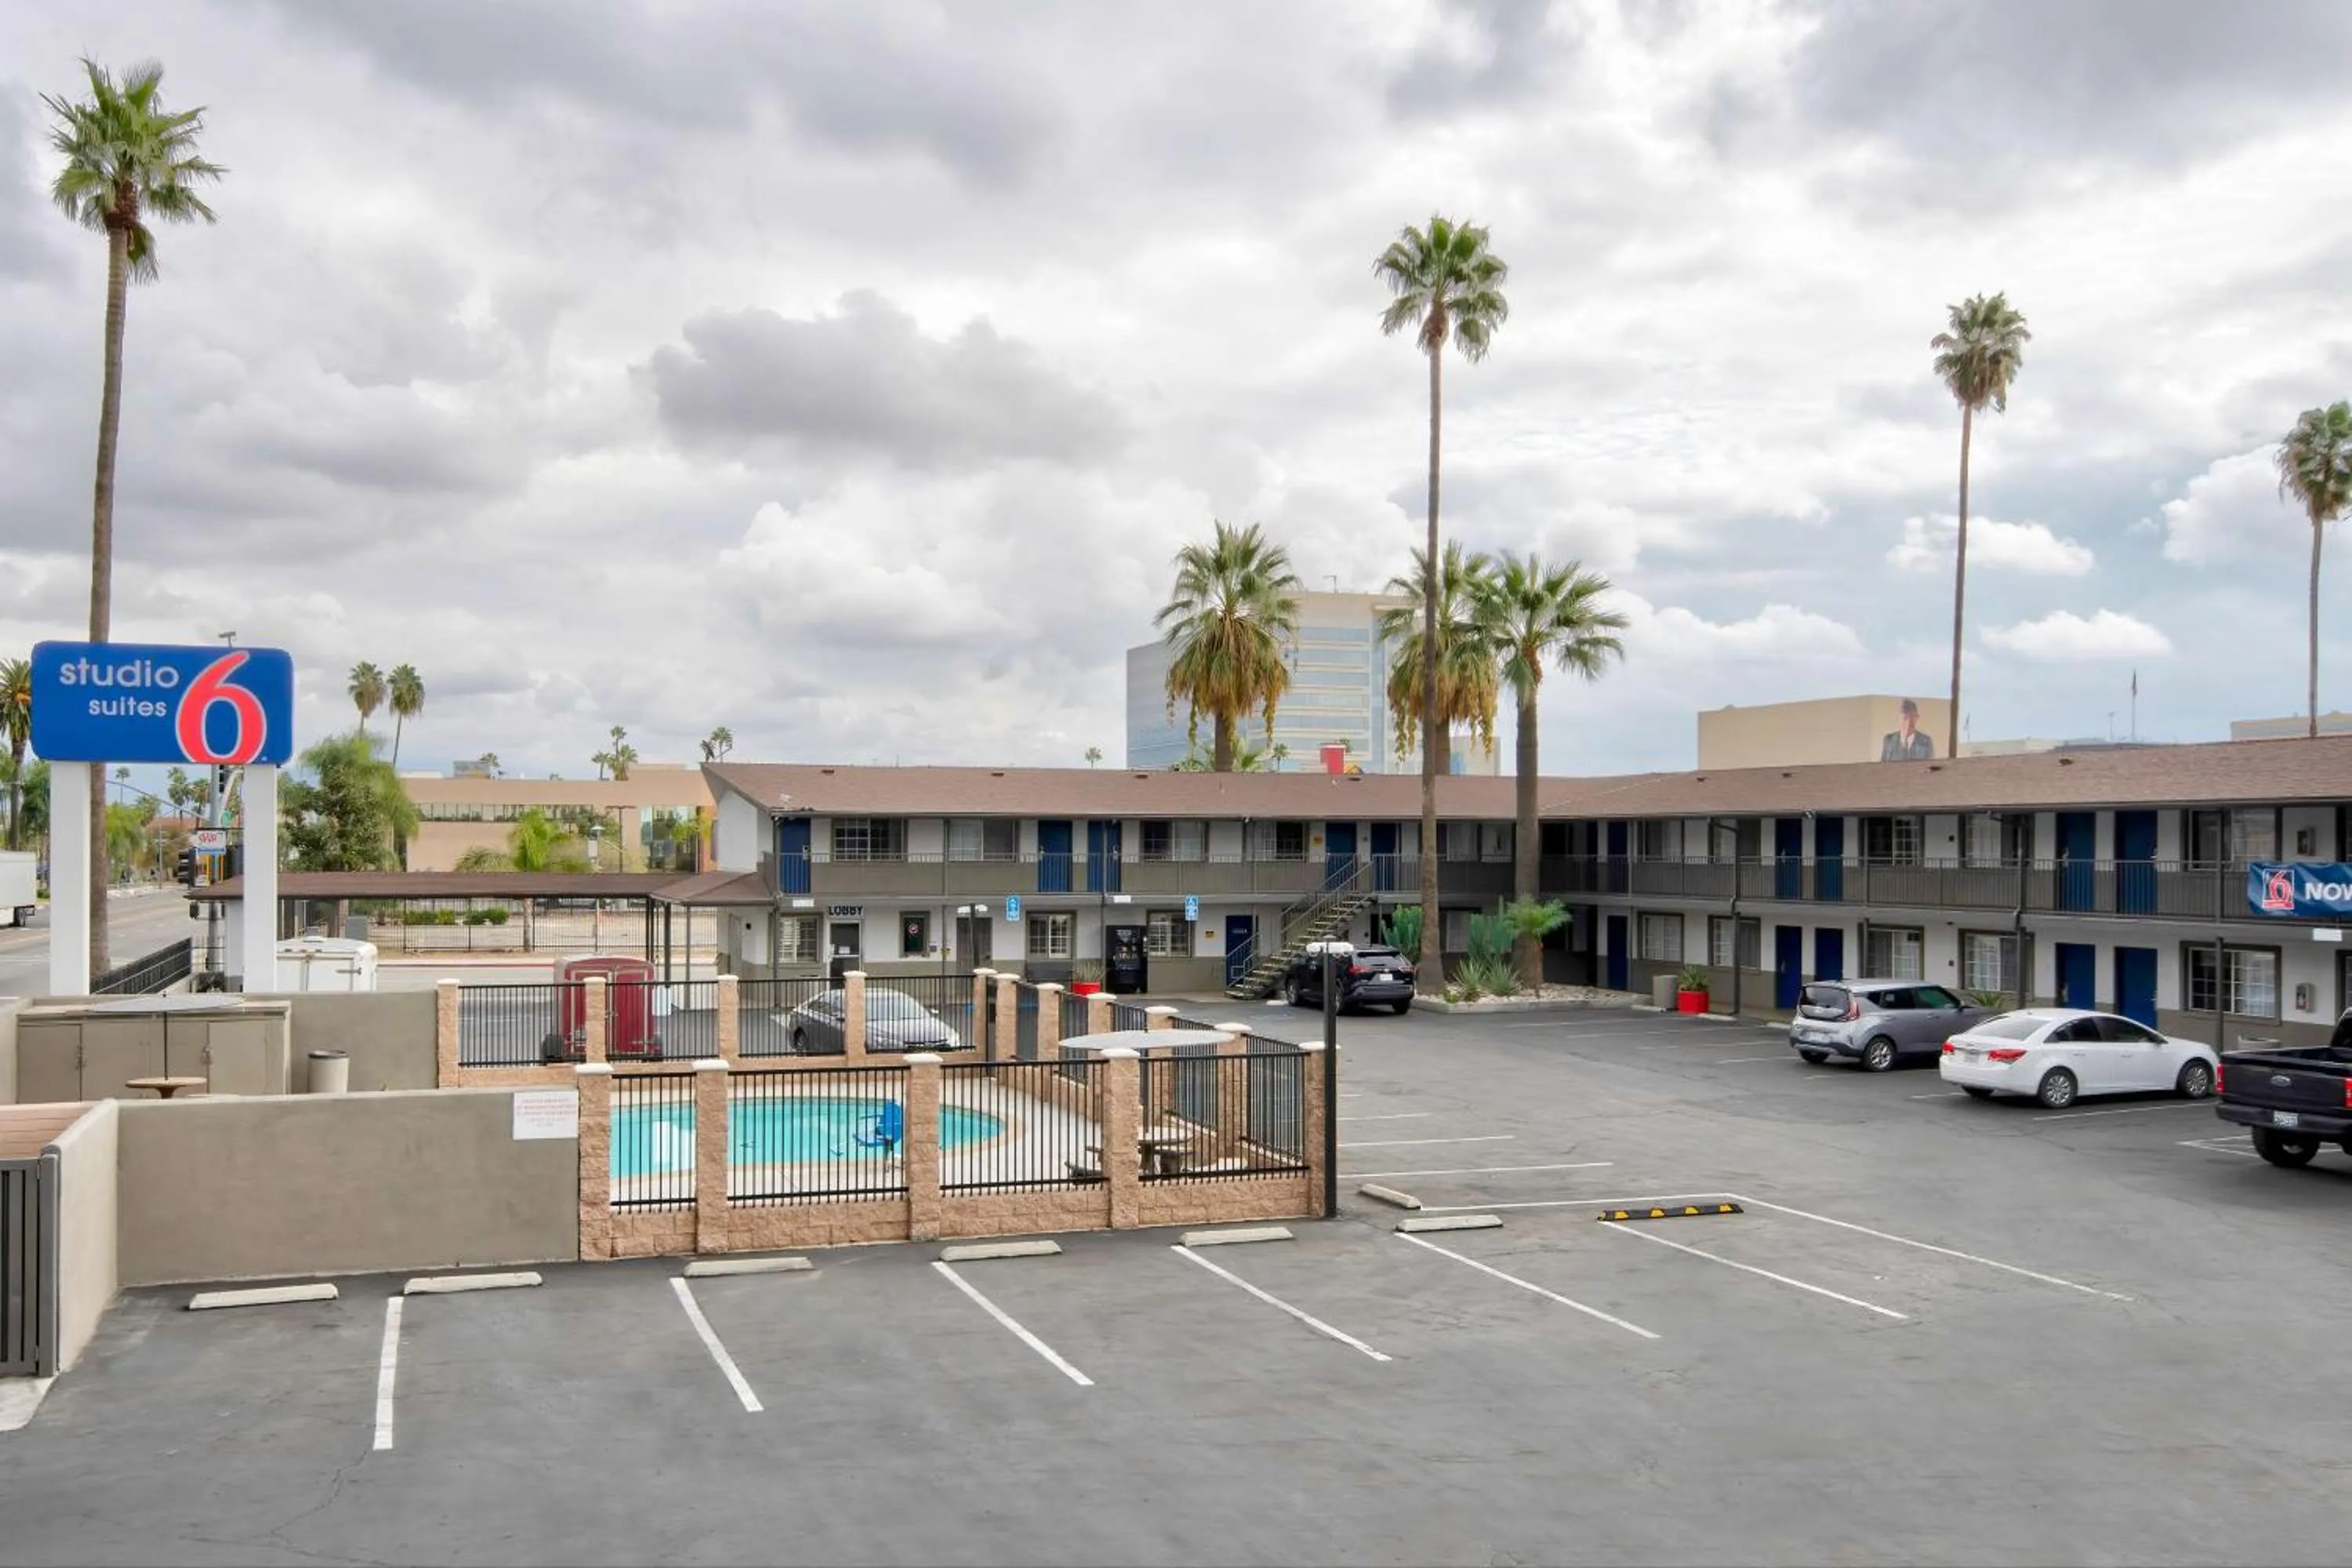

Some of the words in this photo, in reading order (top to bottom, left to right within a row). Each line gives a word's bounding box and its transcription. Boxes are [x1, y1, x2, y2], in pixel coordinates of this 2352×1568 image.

[59, 657, 180, 688] studio
[175, 650, 267, 764] 6
[88, 696, 167, 717] suites
[2269, 869, 2292, 902] 6
[828, 906, 863, 916] LOBBY
